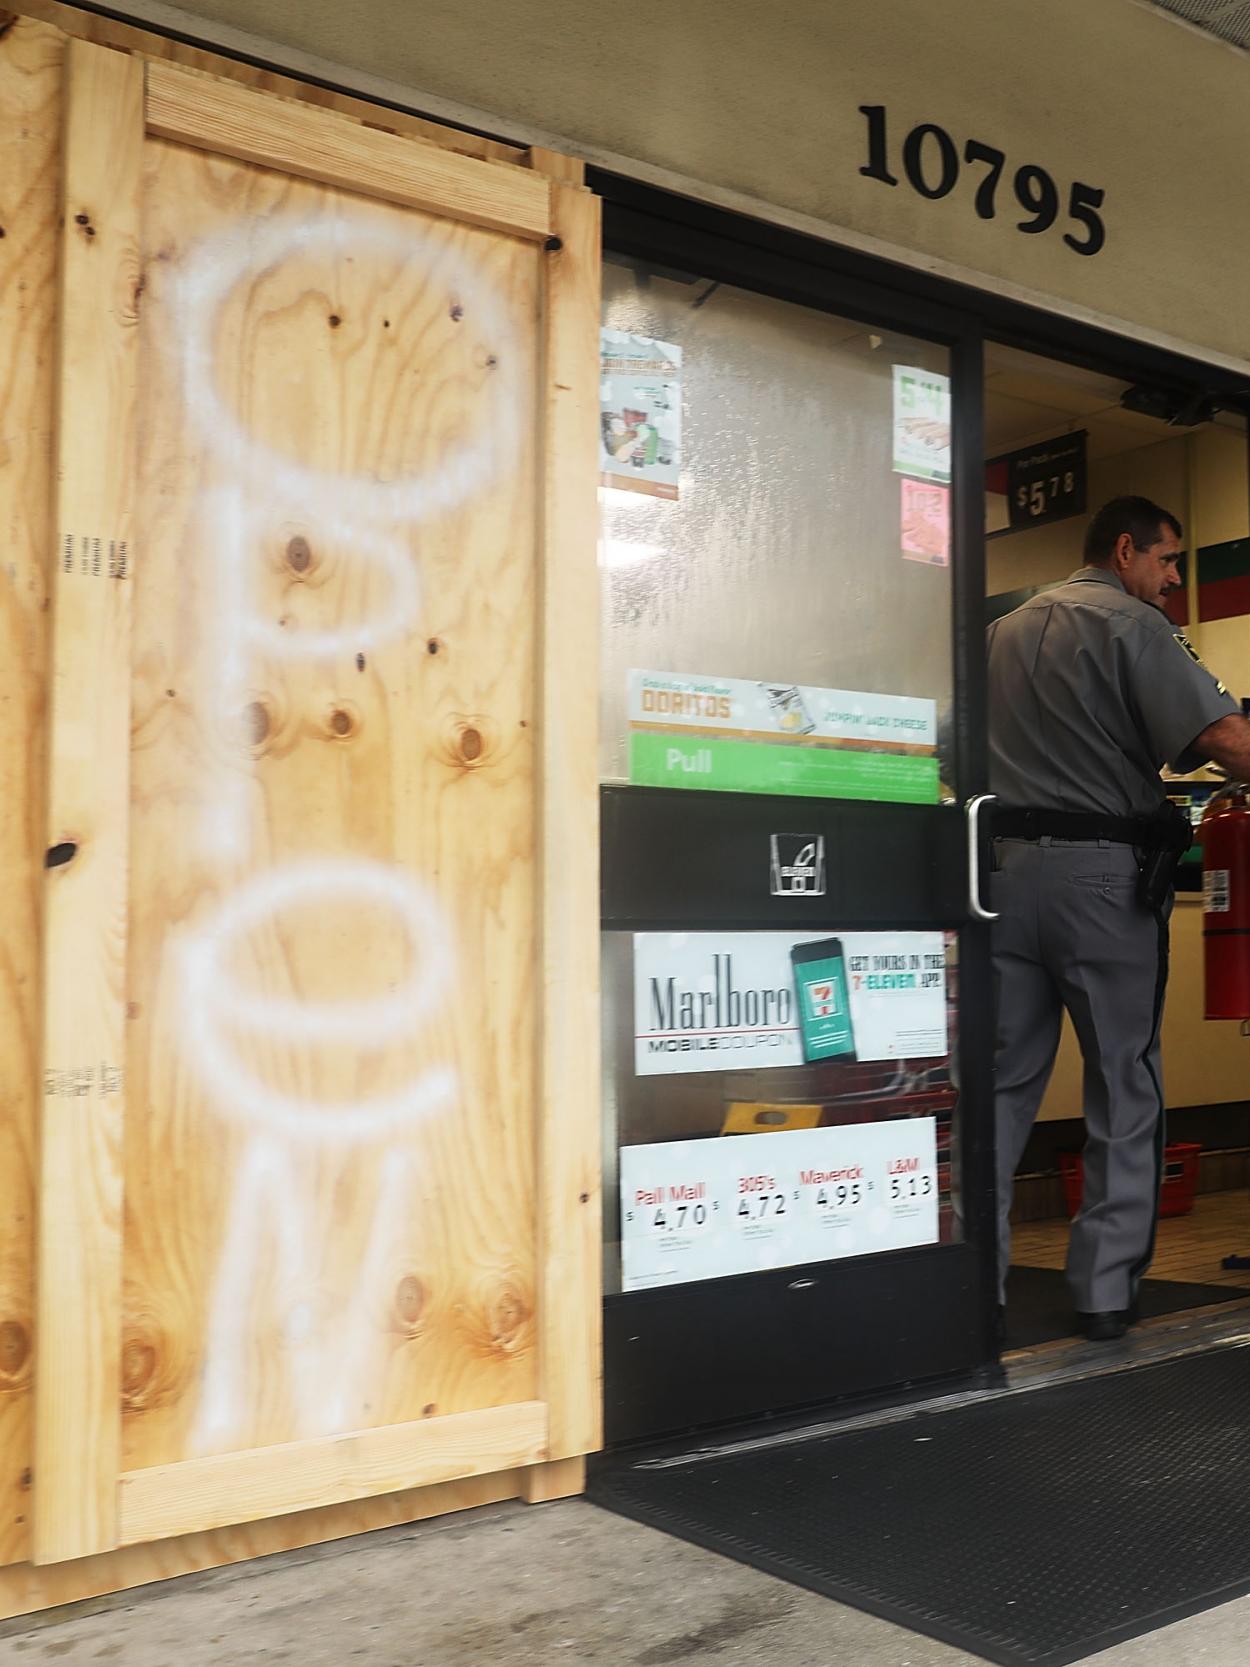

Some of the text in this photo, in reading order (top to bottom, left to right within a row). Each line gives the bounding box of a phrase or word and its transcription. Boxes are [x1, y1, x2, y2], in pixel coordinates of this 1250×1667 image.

[858, 105, 1105, 256] 10795
[641, 689, 732, 718] DORITOS
[666, 748, 712, 774] Pull
[848, 953, 945, 972] GET YOURS IN THE
[649, 953, 791, 1031] Marlboro
[799, 1164, 864, 1187] Maverick
[888, 1157, 920, 1176] L&M
[635, 1182, 706, 1206] Pall Mall
[738, 1175, 777, 1194] 305's
[816, 1184, 862, 1210] 4.95
[889, 1174, 932, 1200] 5.13
[654, 1203, 707, 1233] 4.70
[738, 1194, 787, 1221] 4.72
